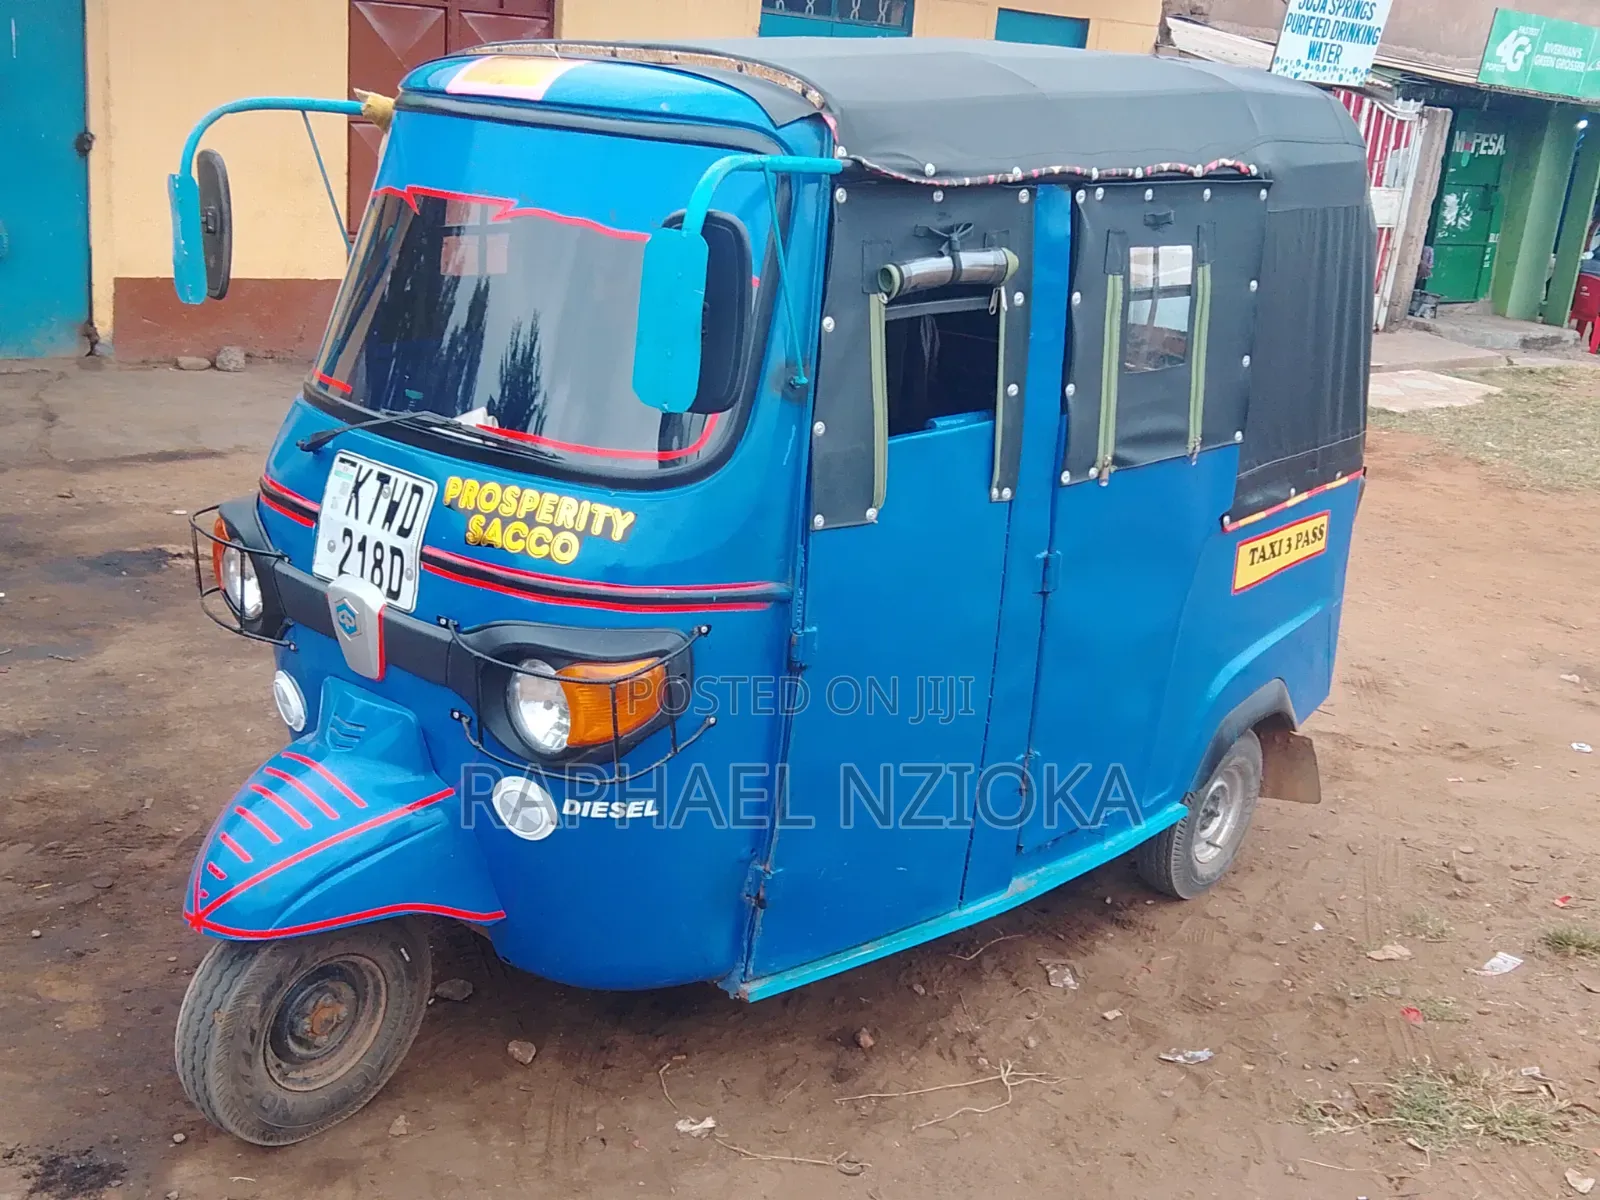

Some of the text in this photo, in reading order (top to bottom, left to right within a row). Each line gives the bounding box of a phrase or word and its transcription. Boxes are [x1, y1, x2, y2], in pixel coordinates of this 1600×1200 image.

[1284, 12, 1382, 46] PURIFIED DRINKING
[1329, 0, 1376, 21] SPRINGS
[1307, 40, 1343, 65] WATER
[1496, 29, 1532, 72] 4G
[345, 464, 424, 539] KTWD
[443, 475, 635, 542] PROSPERITY
[466, 514, 580, 565] SACCO
[1248, 523, 1325, 566] TAXI 3 PASS
[338, 527, 405, 601] 218D
[562, 798, 659, 818] DIESEL
